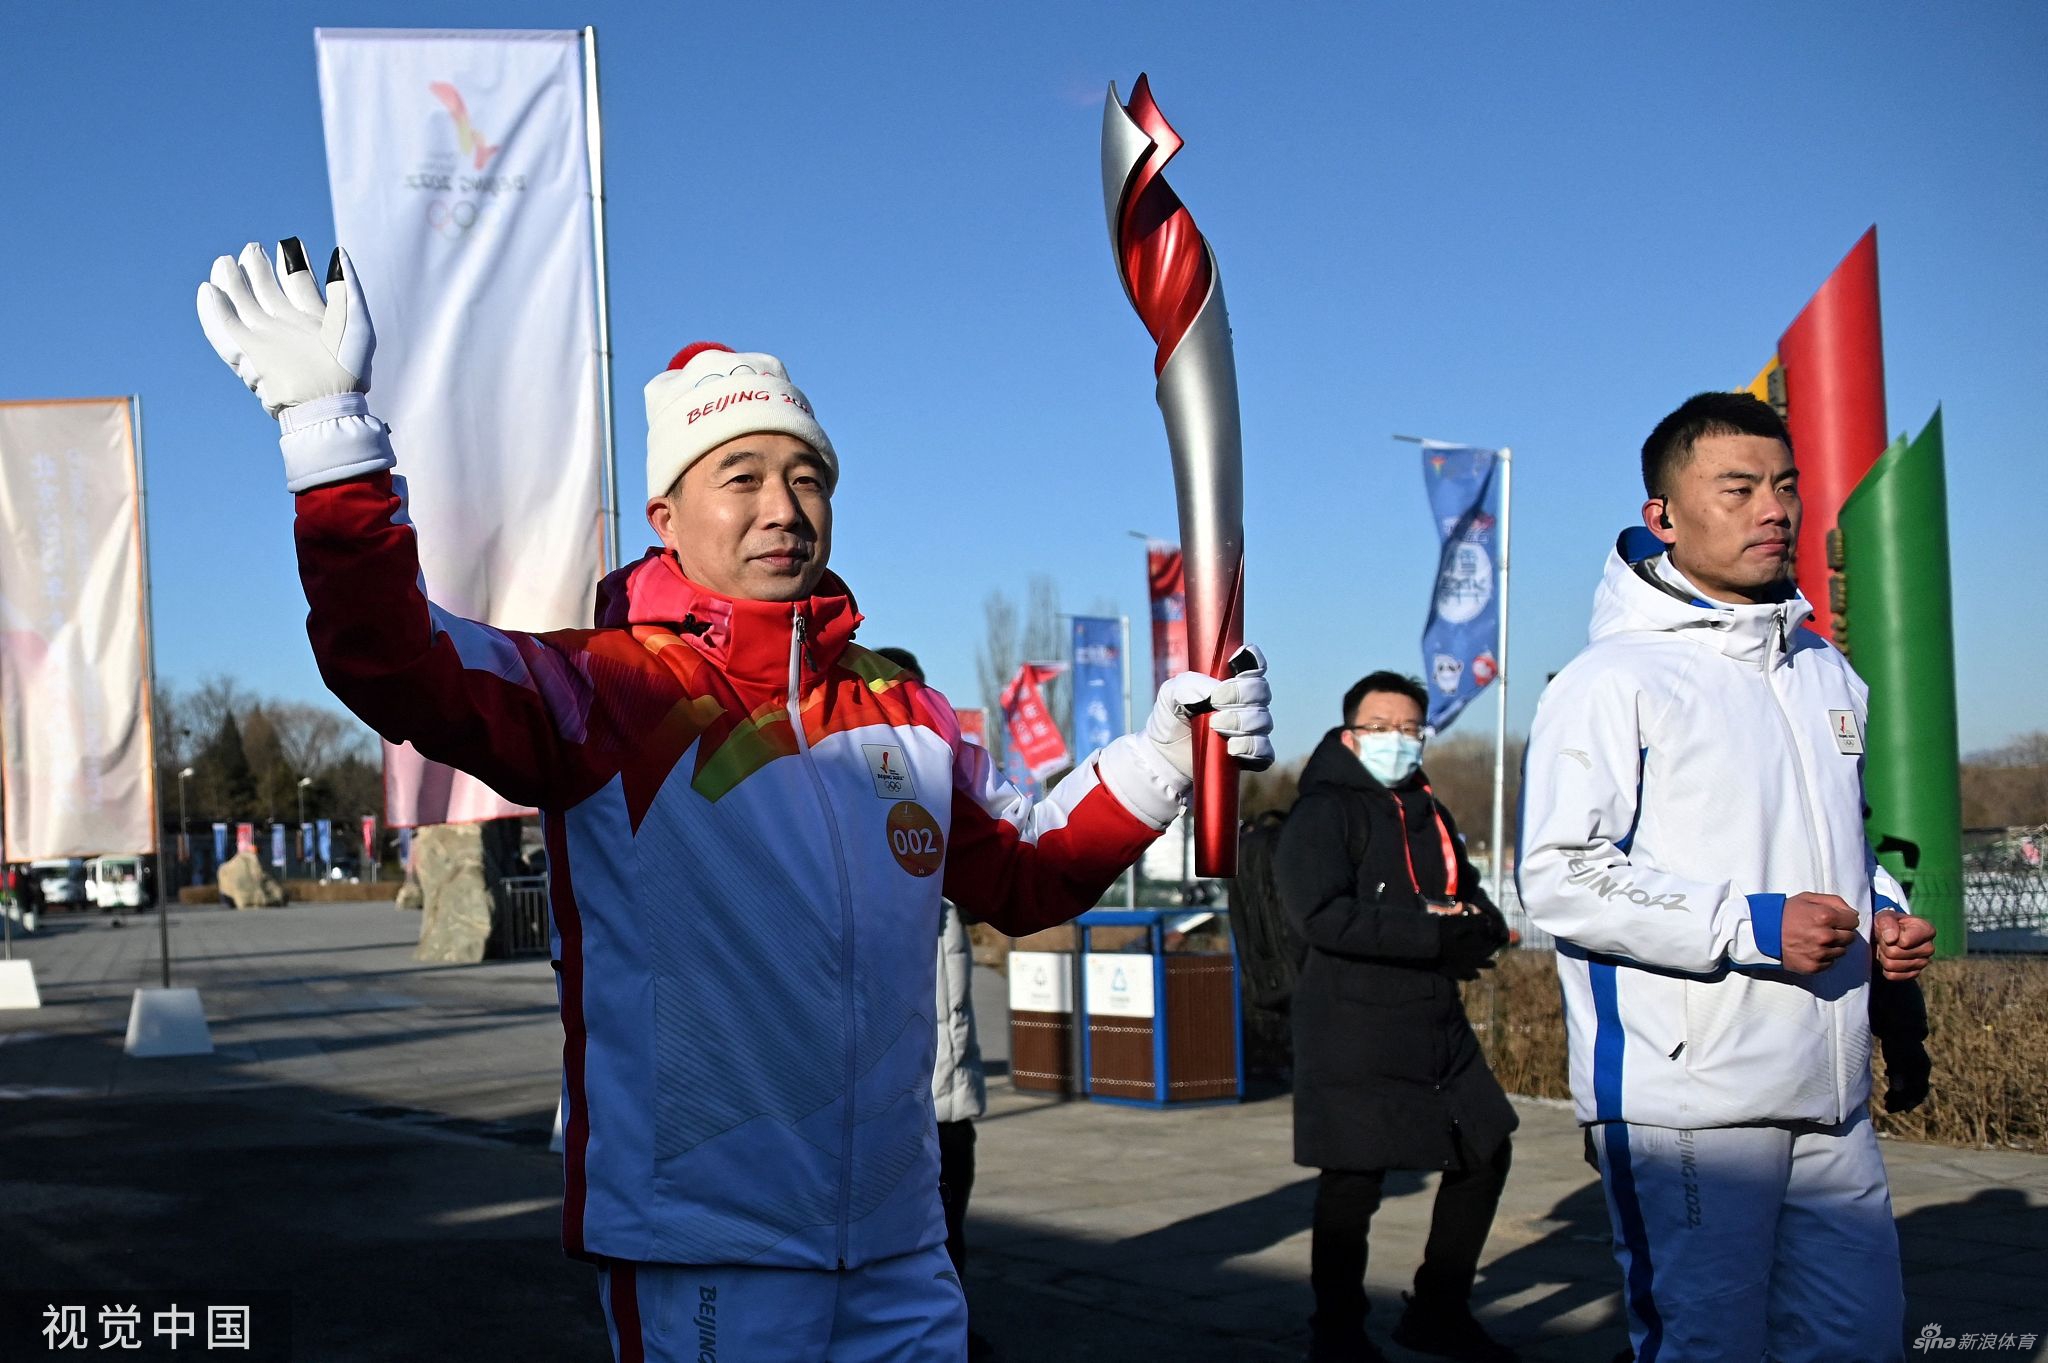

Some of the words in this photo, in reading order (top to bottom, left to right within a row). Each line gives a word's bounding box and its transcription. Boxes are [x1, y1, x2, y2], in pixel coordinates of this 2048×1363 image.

[686, 390, 770, 425] BEIJING
[893, 828, 938, 856] 002
[1675, 1130, 1697, 1178] EIJING
[693, 1285, 717, 1363] BEIJING
